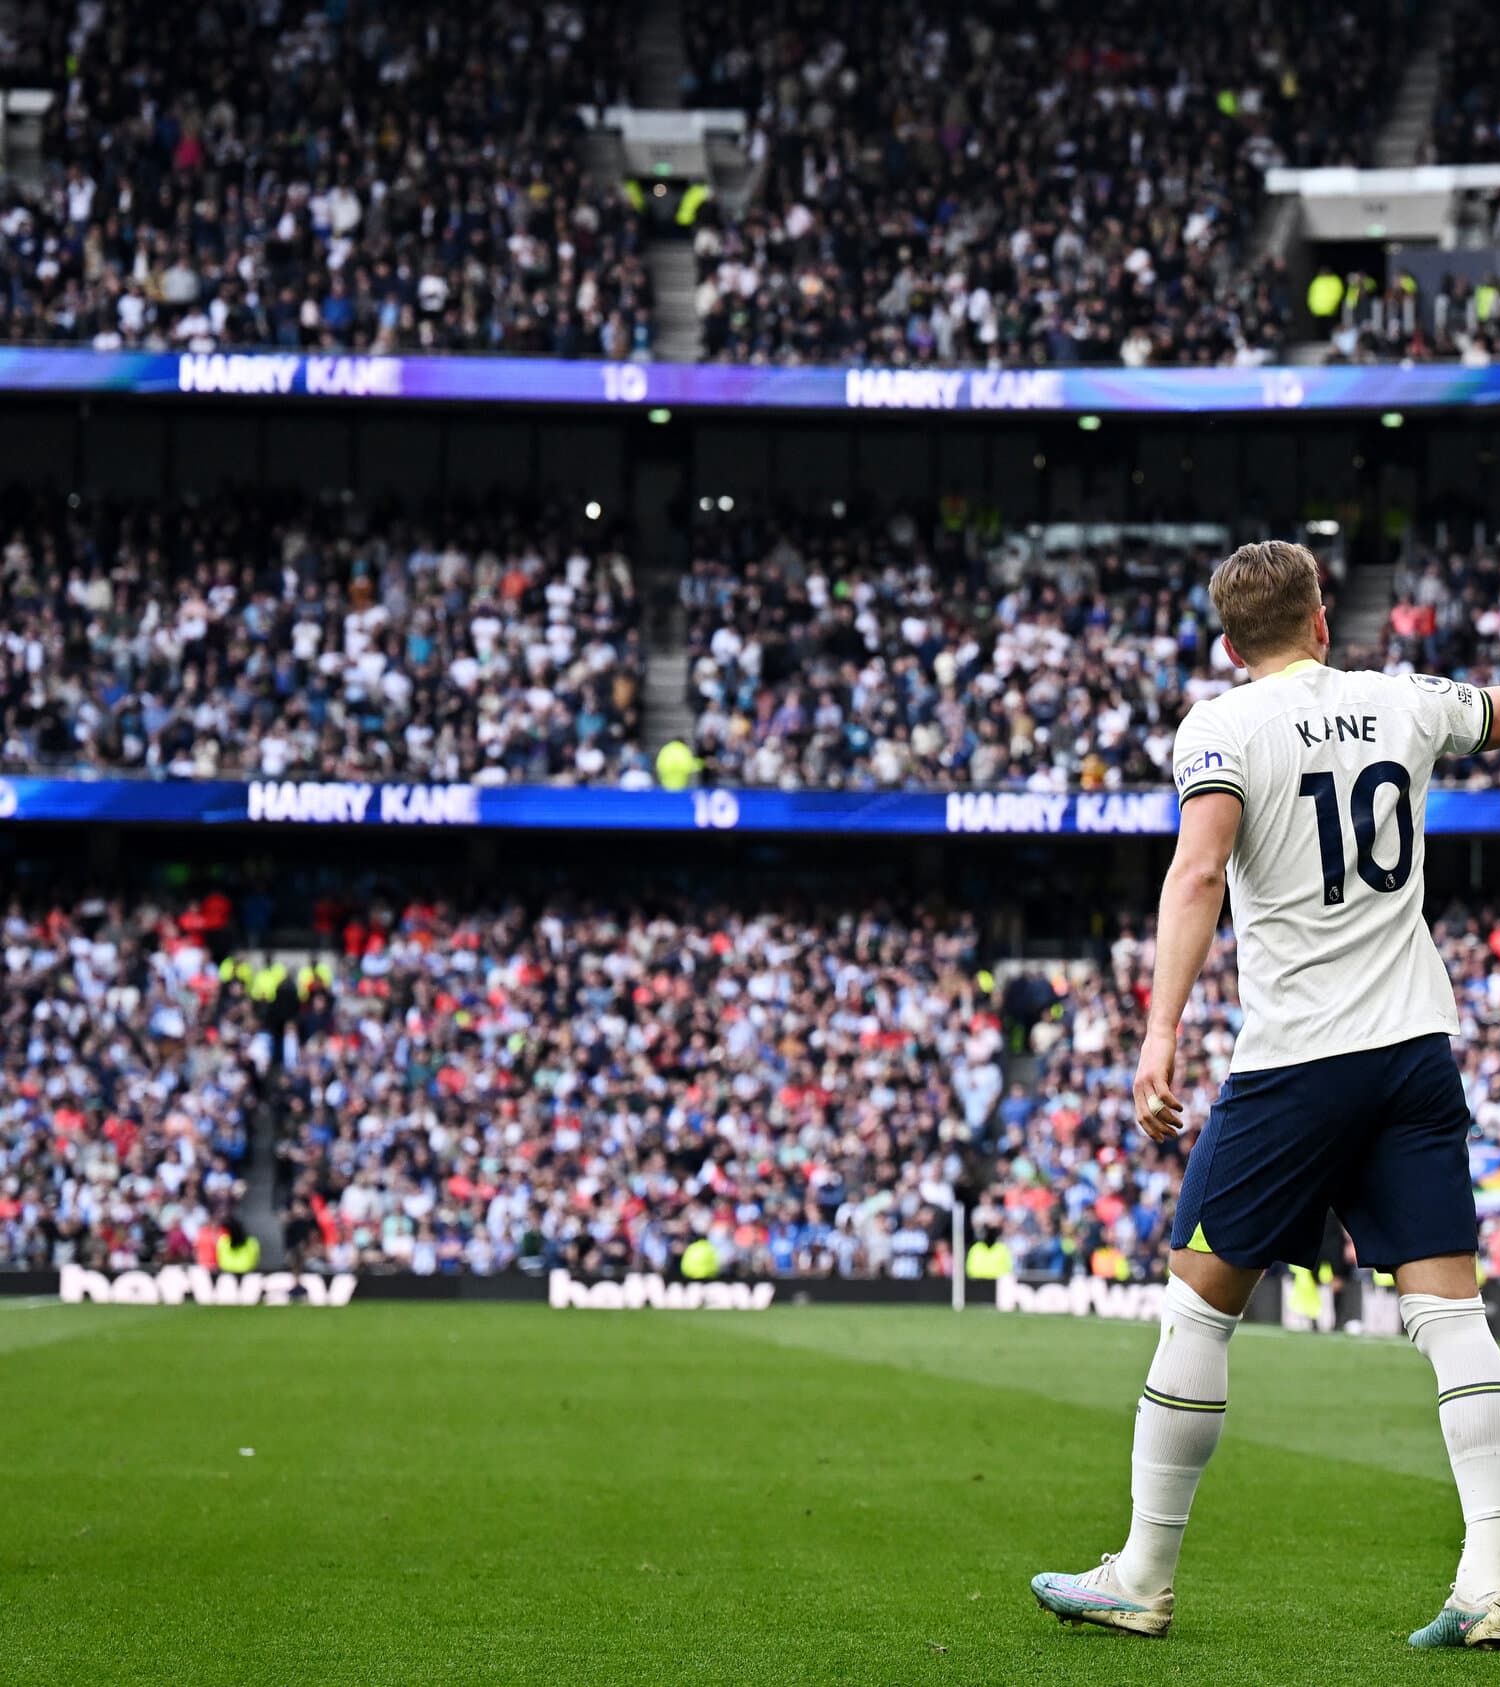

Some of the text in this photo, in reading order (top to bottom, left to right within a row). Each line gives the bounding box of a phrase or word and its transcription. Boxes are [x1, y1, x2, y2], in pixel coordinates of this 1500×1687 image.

[179, 353, 401, 396] HARRY KANE
[846, 369, 1064, 409] HARRY KANE
[1295, 715, 1377, 747] KANE
[1177, 751, 1223, 786] inch
[248, 781, 479, 824] HARRY KANE
[693, 790, 740, 829] 10
[946, 792, 1176, 833] HARRY KANE
[1299, 761, 1414, 905] 10
[550, 1268, 775, 1309] betway
[996, 1274, 1168, 1321] betwa
